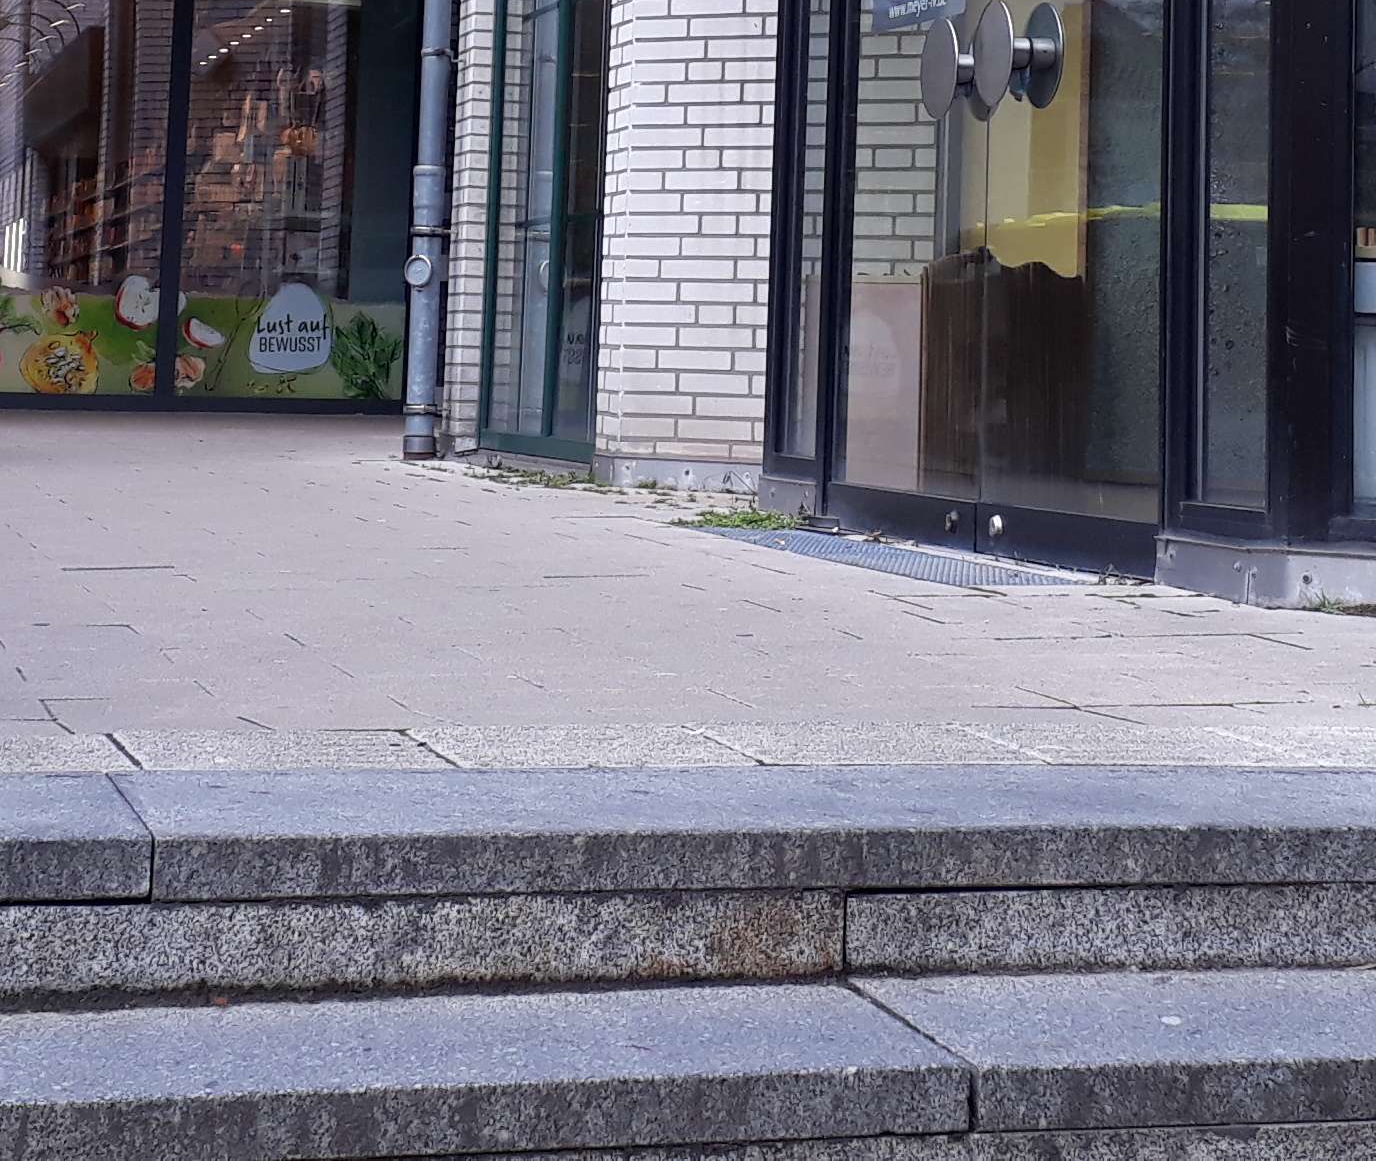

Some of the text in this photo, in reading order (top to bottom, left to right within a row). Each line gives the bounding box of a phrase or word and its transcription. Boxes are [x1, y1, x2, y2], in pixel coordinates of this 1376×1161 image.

[257, 313, 330, 340] Lust auf
[259, 336, 321, 353] BEWUSST
